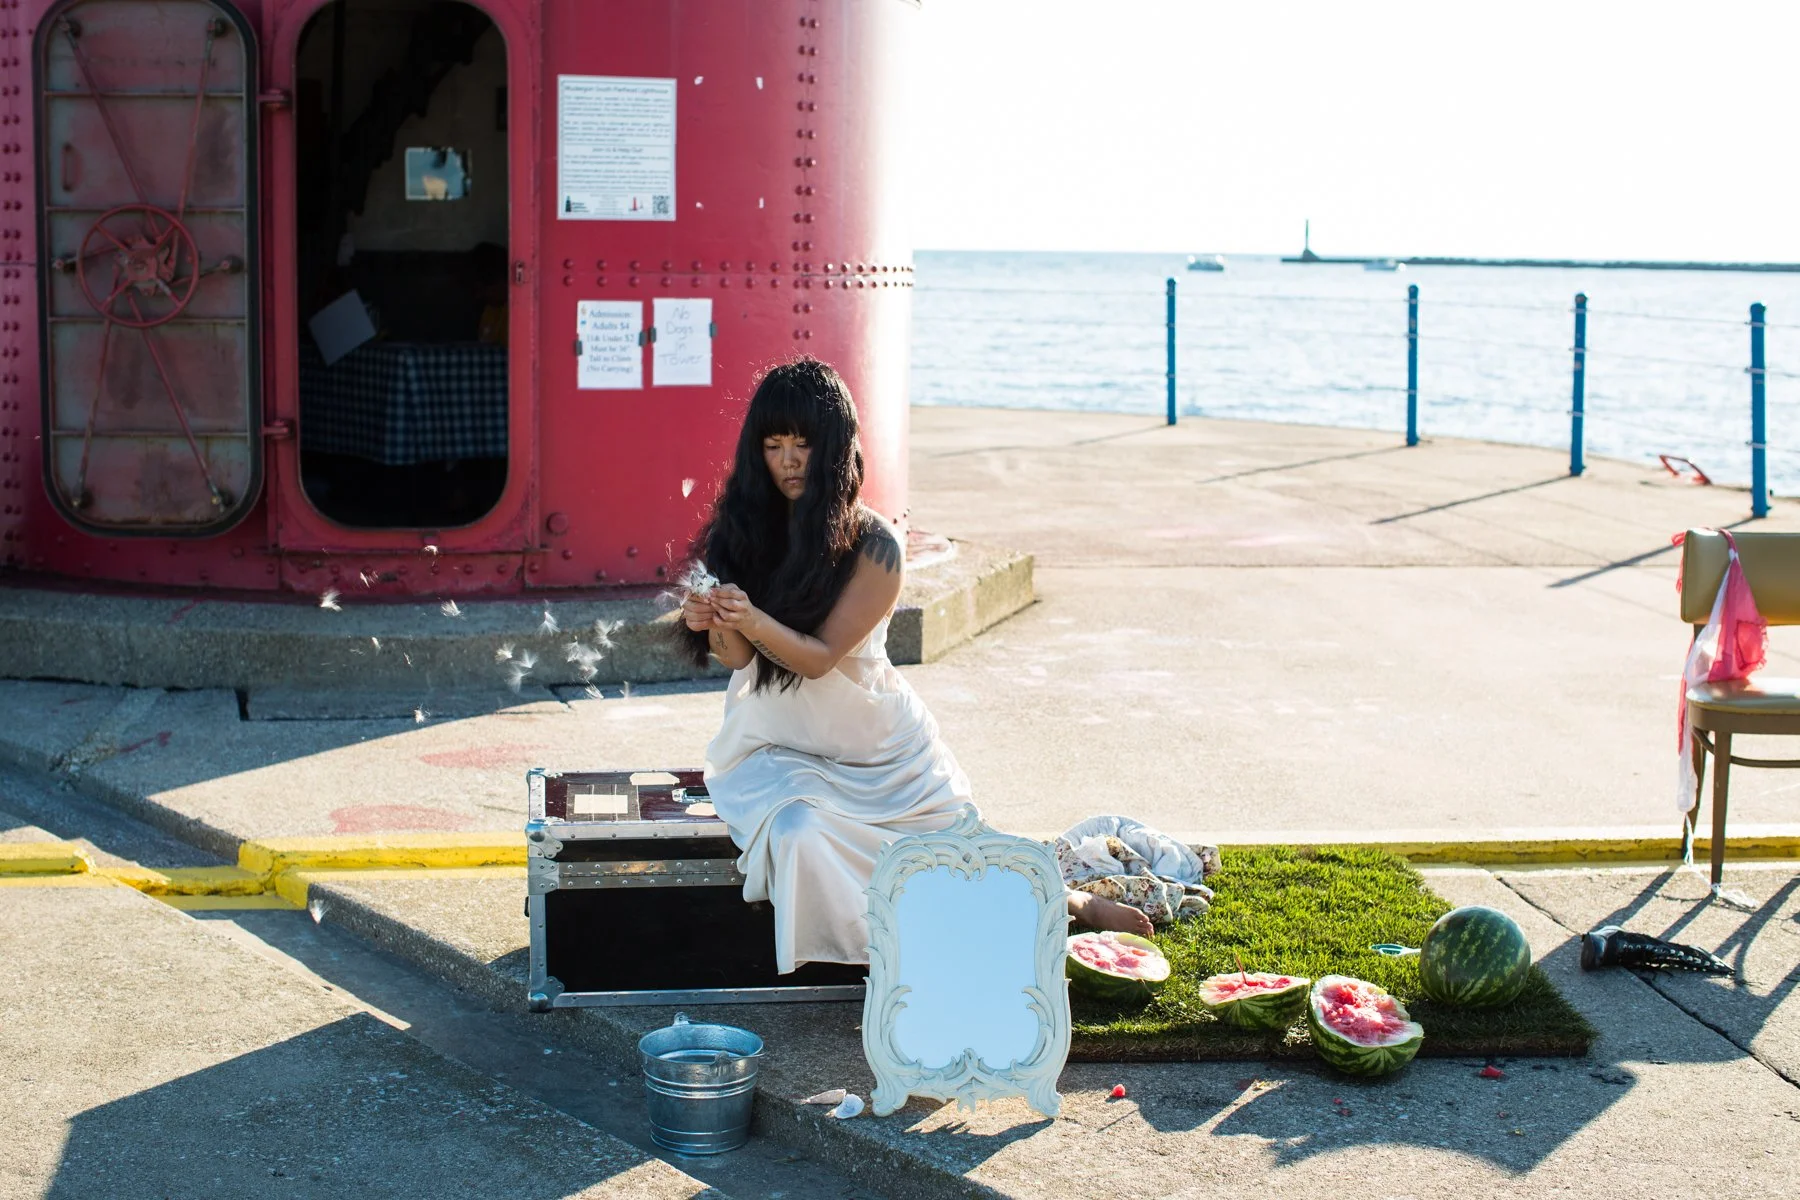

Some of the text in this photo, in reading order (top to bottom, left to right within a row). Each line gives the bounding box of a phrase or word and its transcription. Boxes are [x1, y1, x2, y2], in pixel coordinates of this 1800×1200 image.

[672, 304, 691, 320] No
[592, 321, 630, 330] Adults $4
[666, 321, 694, 340] Dogs
[602, 333, 622, 342] Under
[624, 334, 635, 342] $2
[591, 344, 607, 352] Must
